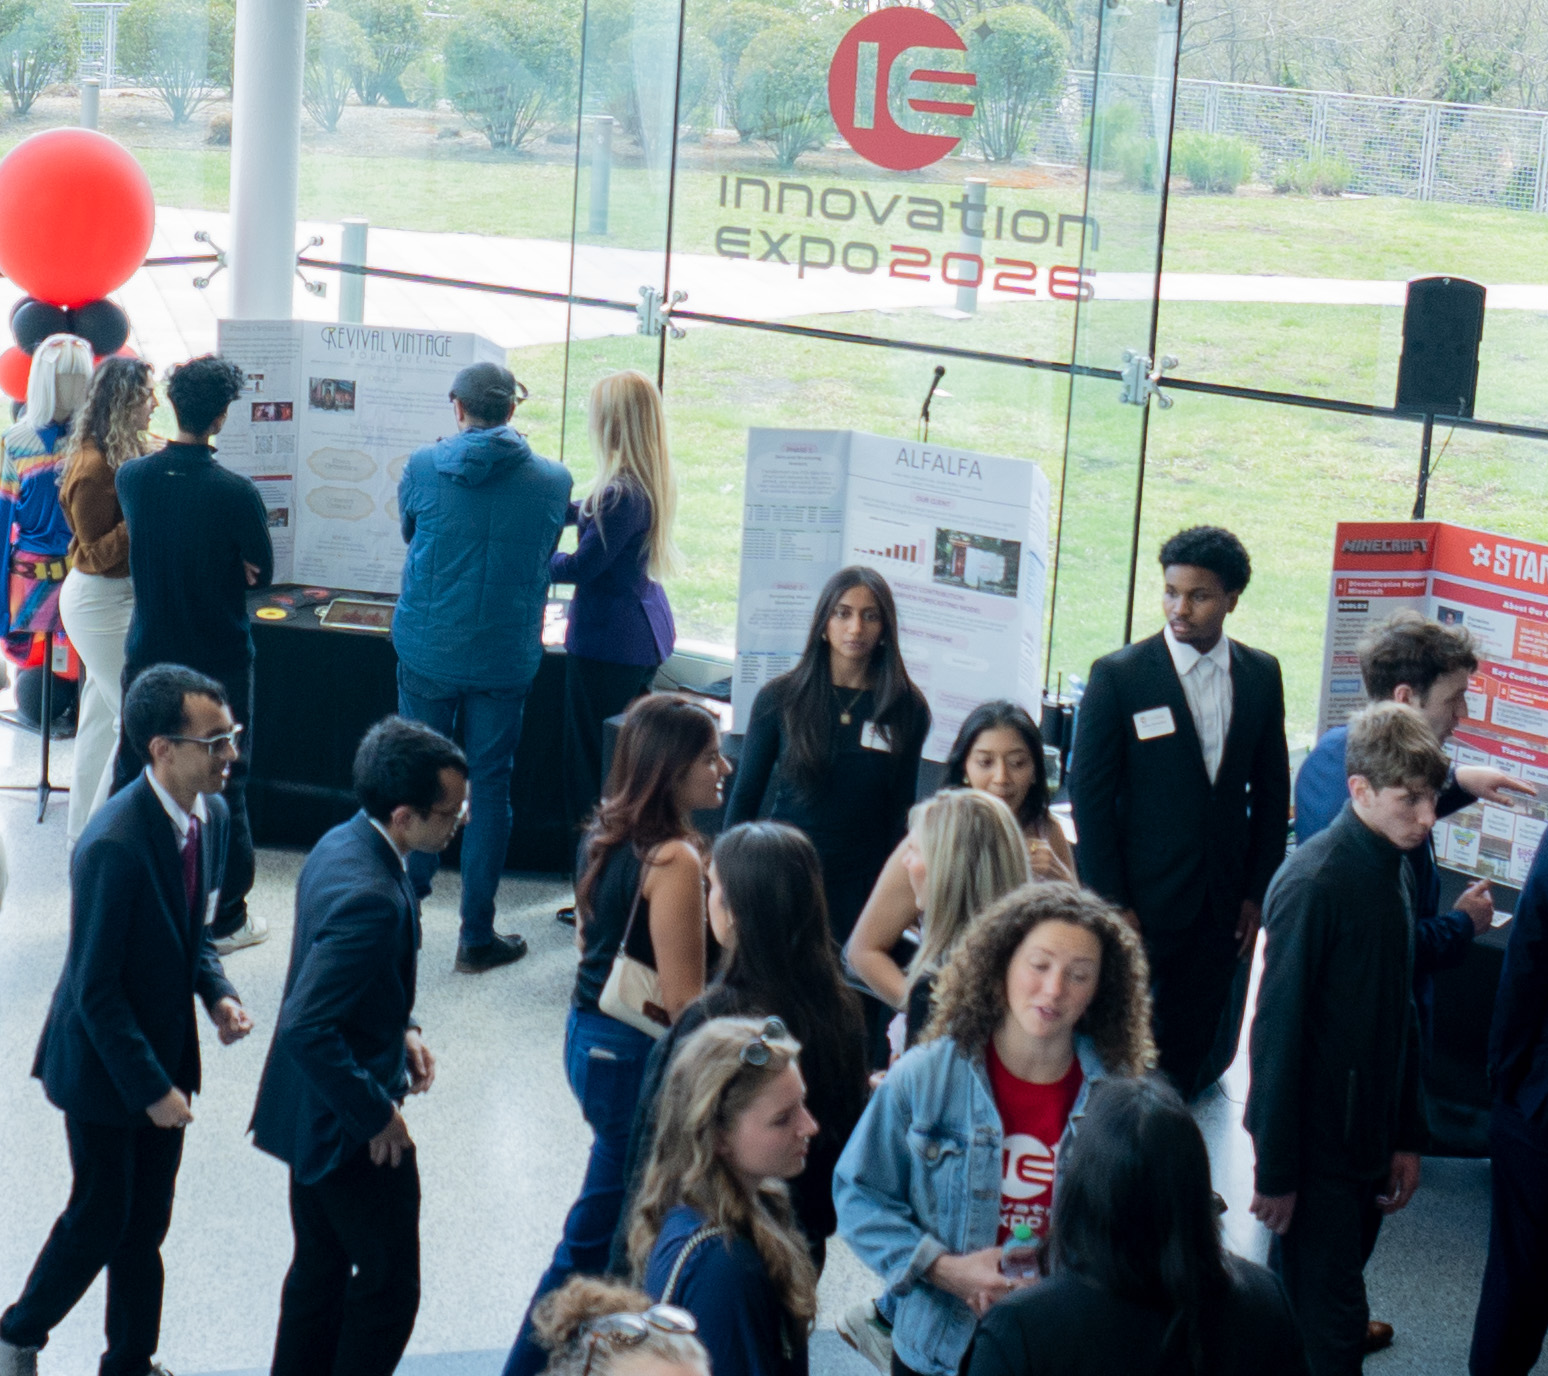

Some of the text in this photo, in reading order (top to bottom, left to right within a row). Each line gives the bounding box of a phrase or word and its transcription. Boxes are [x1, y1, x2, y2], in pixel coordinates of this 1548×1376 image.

[719, 175, 1100, 251] innovation
[715, 225, 1097, 302] expo2026
[321, 326, 387, 353] REVIVAL
[392, 332, 452, 357] VINTAGE
[895, 447, 983, 480] ALFALFA
[1341, 538, 1429, 555] MINECRAFT
[1503, 601, 1528, 613] About
[1528, 607, 1544, 617] Our
[1492, 667, 1507, 679] Key
[1501, 745, 1536, 761] Timeline
